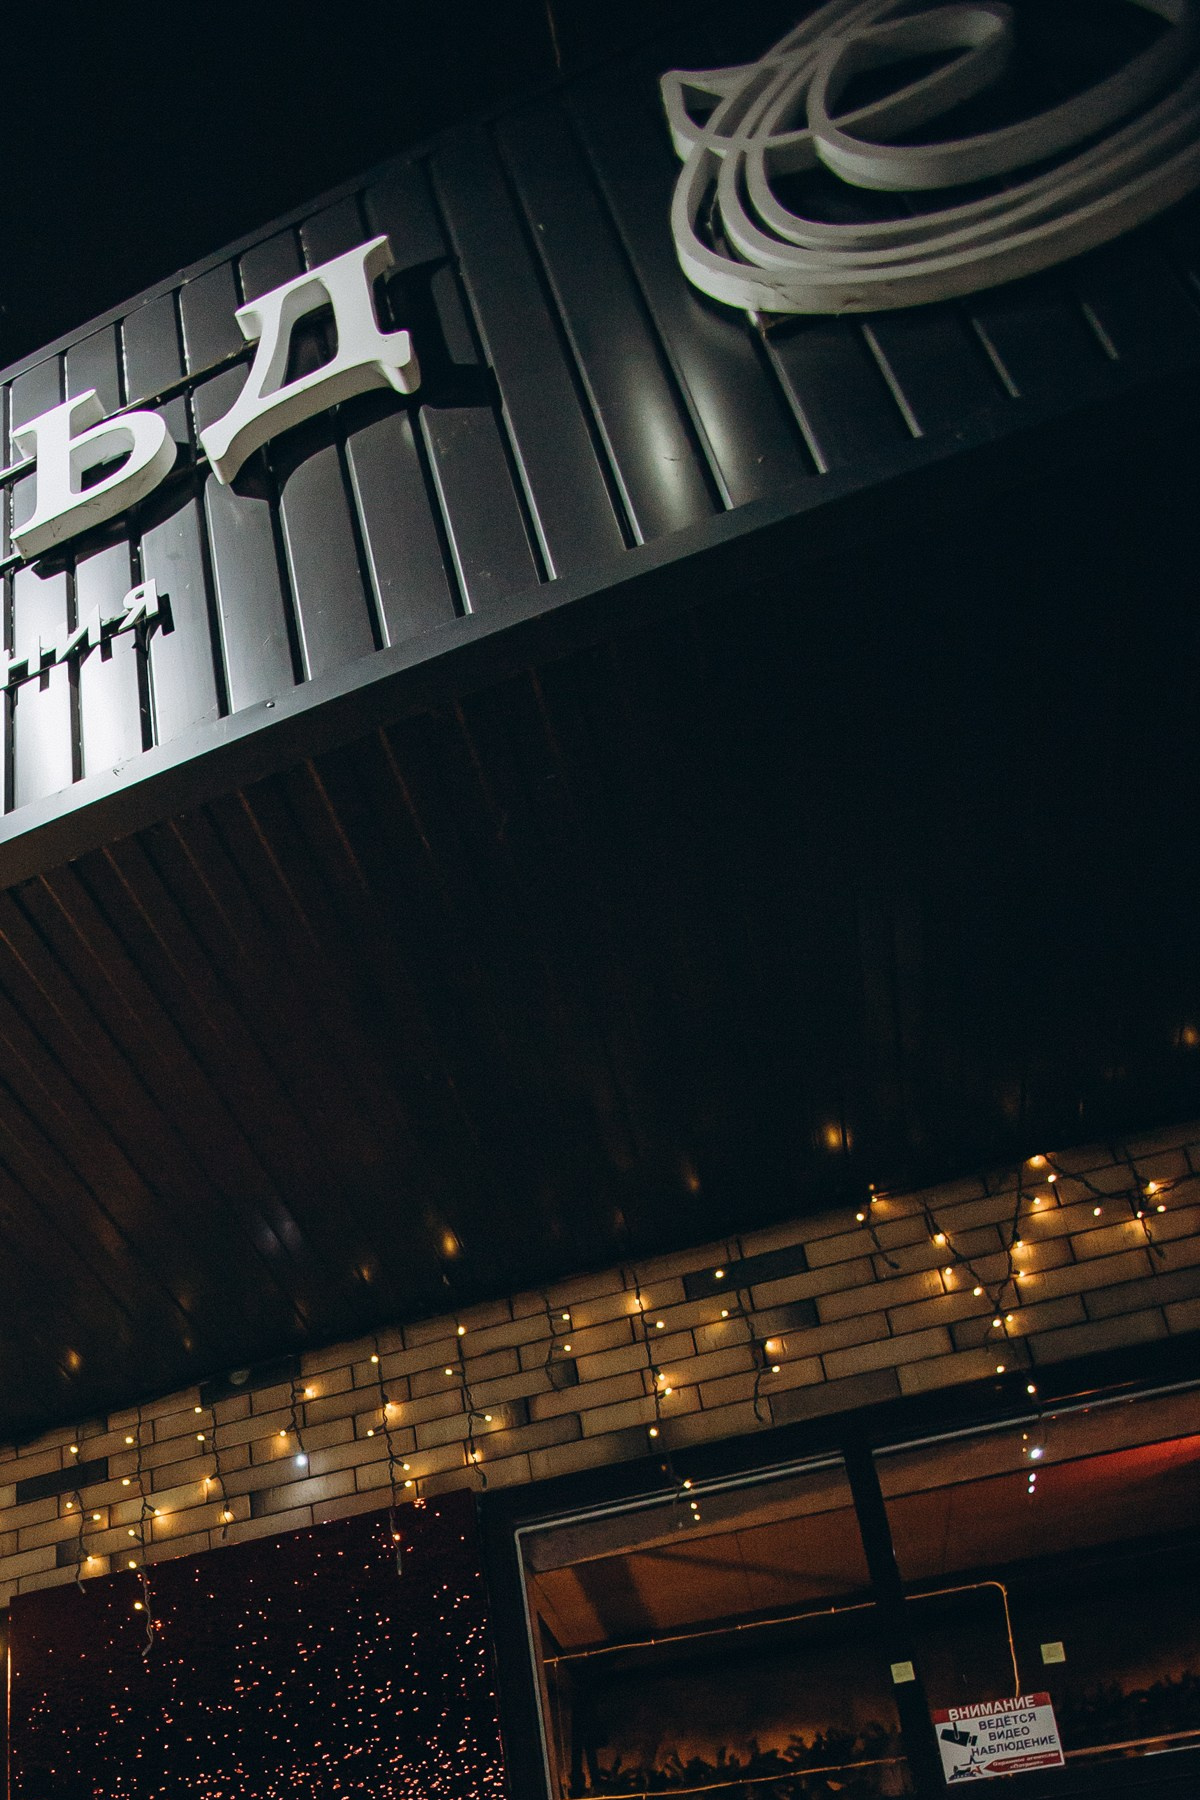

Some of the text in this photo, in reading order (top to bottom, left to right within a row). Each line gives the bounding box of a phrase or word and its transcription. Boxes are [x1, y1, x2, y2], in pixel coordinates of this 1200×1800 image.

[948, 1695, 1036, 1722] ВНИМАНИЕ
[978, 1712, 1037, 1730] ВЕДЁТСЯ
[988, 1726, 1030, 1741] ВИДЕО
[971, 1734, 1057, 1757] НАБЛЮДЕНИЕ
